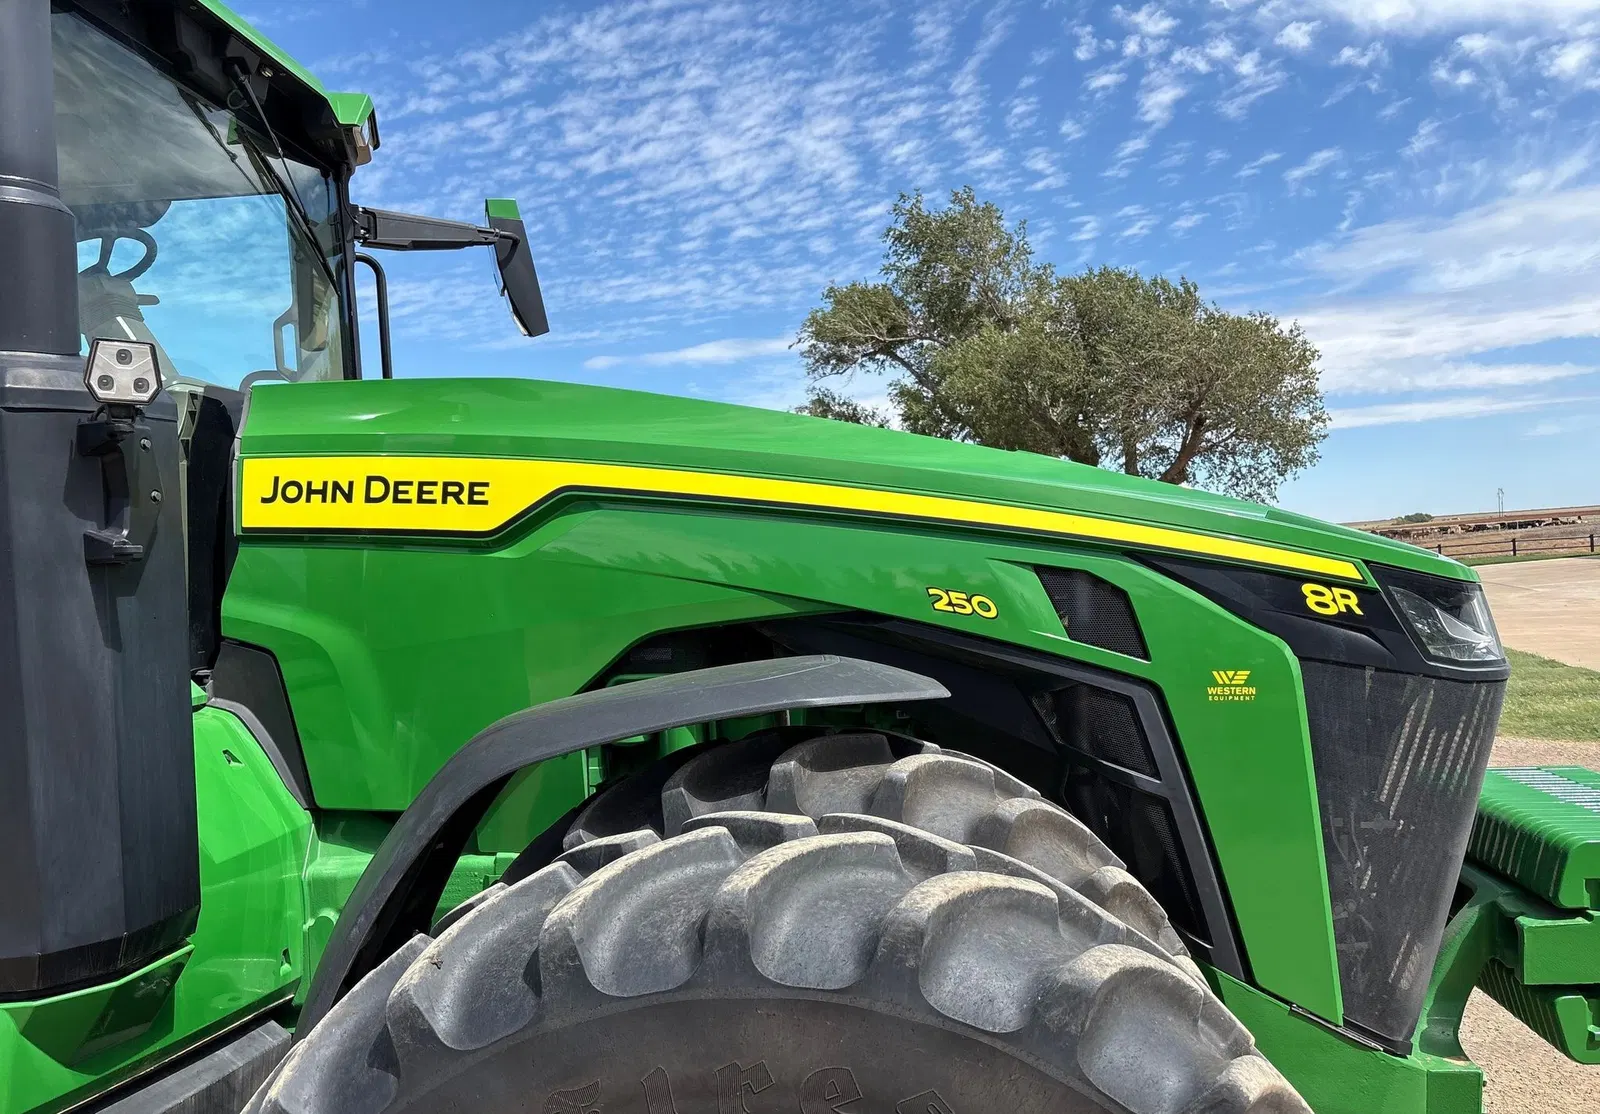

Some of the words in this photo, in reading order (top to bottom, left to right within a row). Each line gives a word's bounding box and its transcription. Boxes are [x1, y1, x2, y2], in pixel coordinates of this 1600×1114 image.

[260, 475, 354, 504] JOHN
[364, 475, 490, 506] DEERE
[926, 586, 998, 619] 250
[1301, 583, 1364, 616] 8R
[1207, 686, 1256, 695] WESTERN
